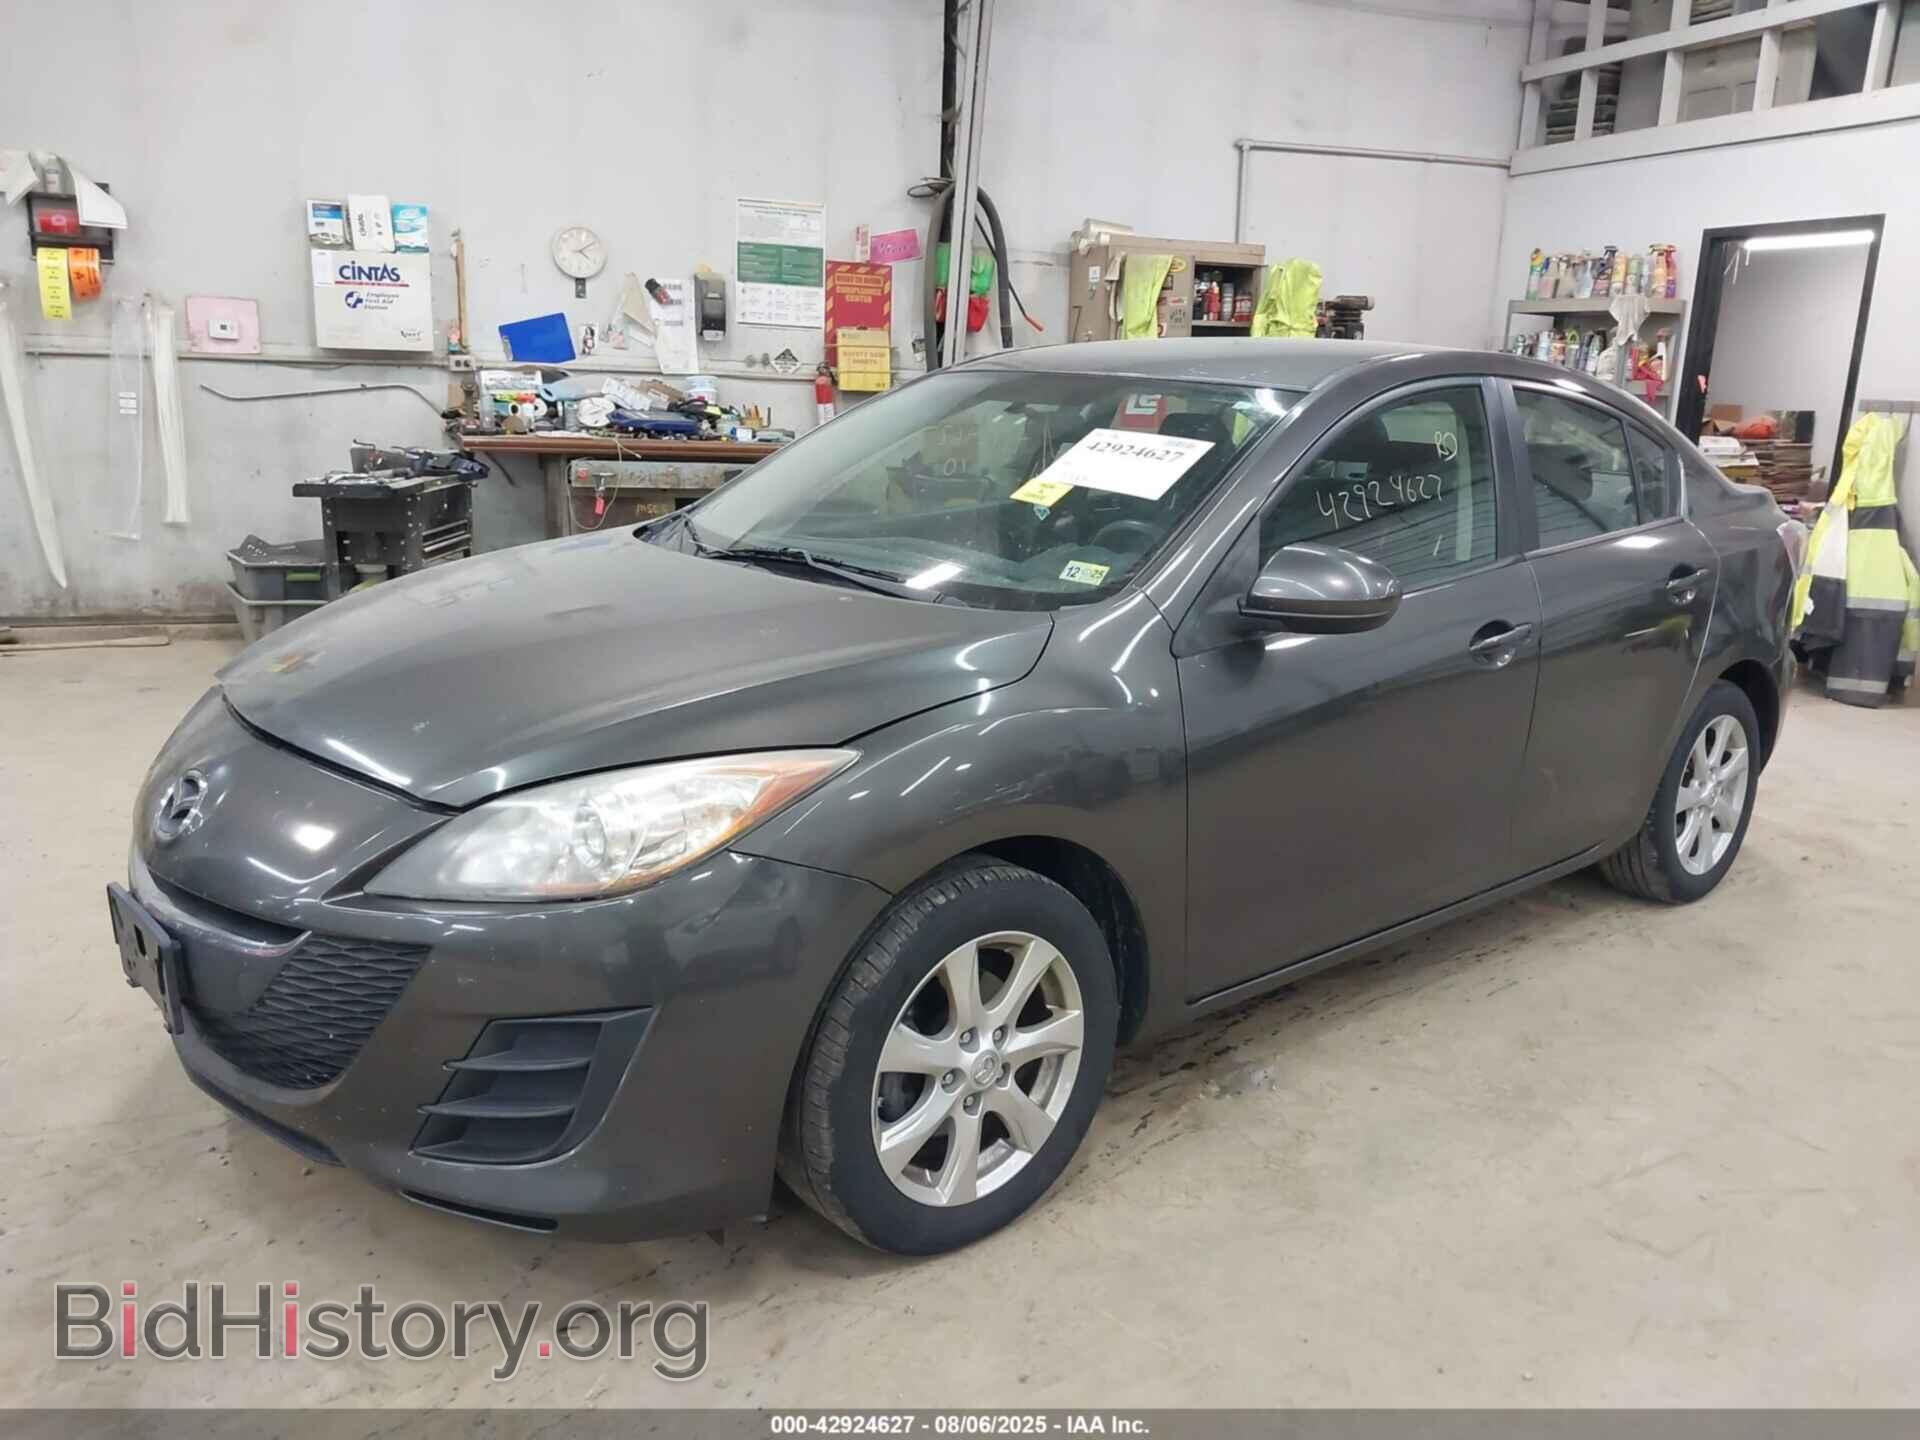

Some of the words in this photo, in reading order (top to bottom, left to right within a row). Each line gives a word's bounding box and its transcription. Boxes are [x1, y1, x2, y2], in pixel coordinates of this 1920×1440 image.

[338, 260, 401, 282] CINTAS
[1086, 441, 1185, 462] 42924627
[1316, 474, 1442, 530] 42924627
[1066, 566, 1081, 578] 12
